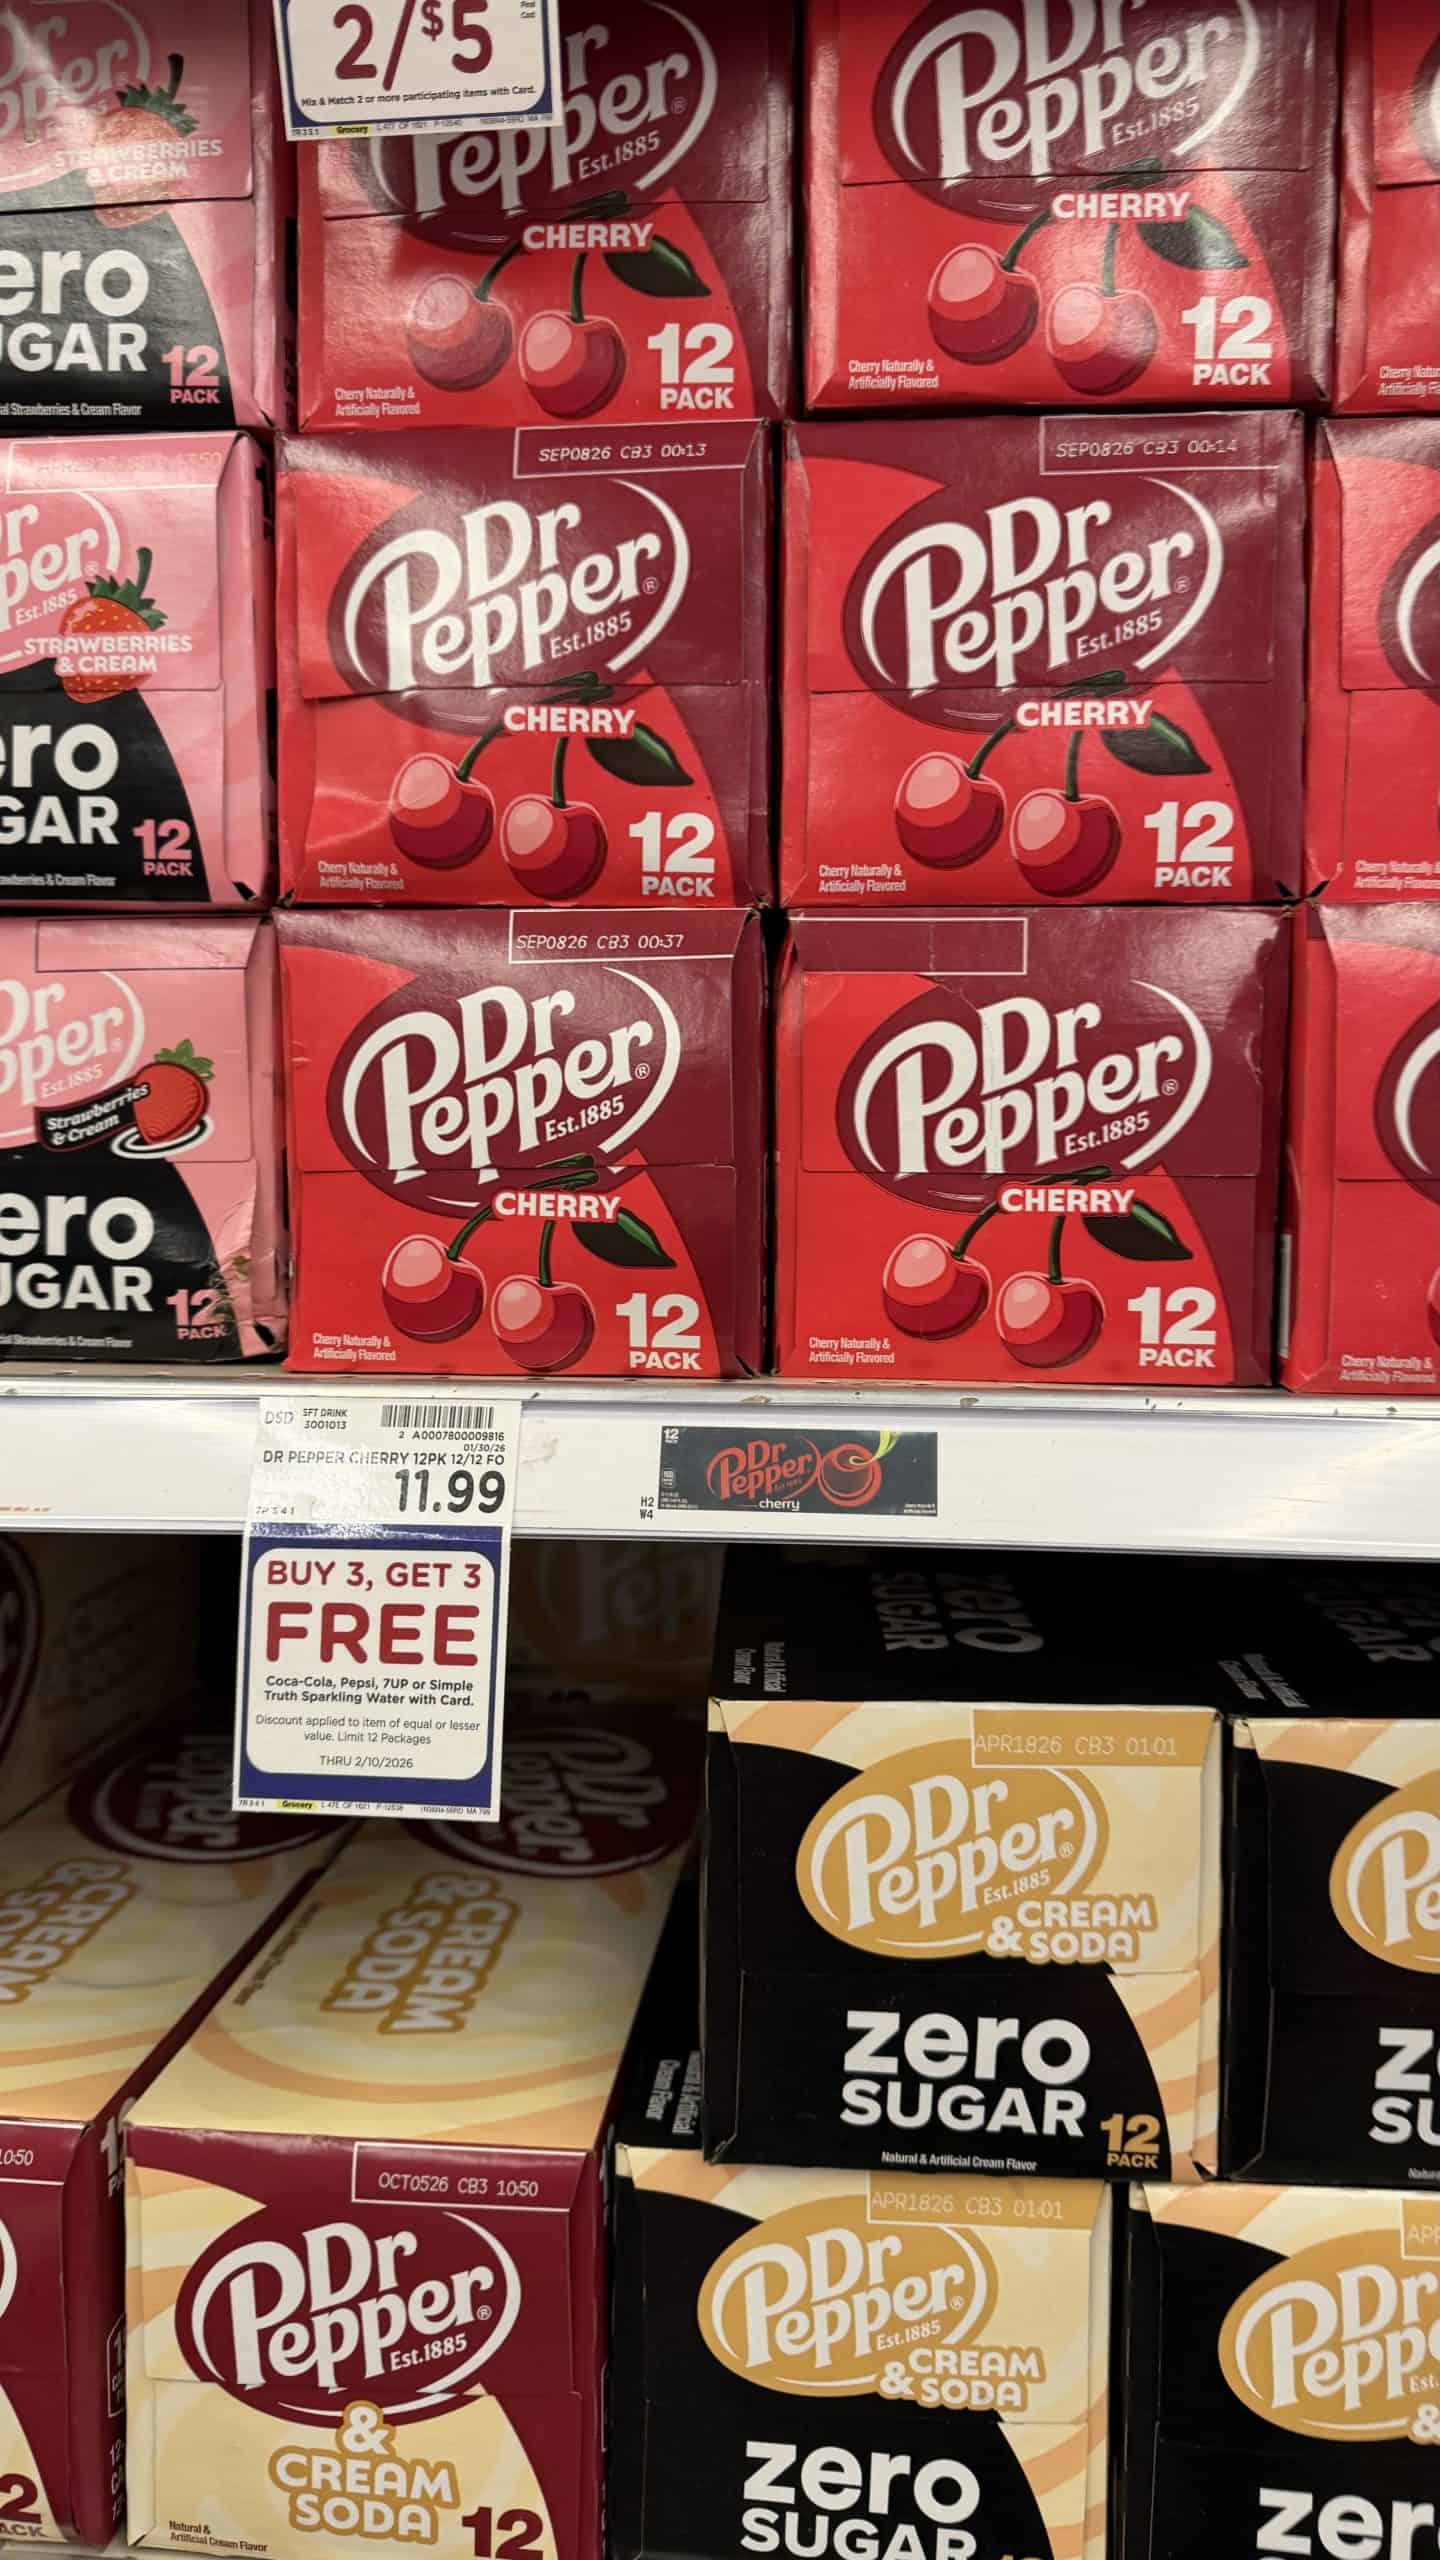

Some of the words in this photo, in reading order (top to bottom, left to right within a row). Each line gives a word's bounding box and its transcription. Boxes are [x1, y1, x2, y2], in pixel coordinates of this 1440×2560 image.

[333, 0, 493, 91] 2/$5
[1024, 0, 1147, 85] Dr
[328, 95, 355, 105] Match
[377, 94, 400, 102] more
[402, 89, 460, 103] participating
[462, 87, 489, 98] items
[490, 86, 510, 96] with
[891, 9, 1232, 188] Pepper
[1051, 191, 1192, 219] CHERRY
[521, 222, 654, 251] CHERRY
[1181, 295, 1272, 360] 12
[161, 344, 220, 387] 12
[1191, 362, 1272, 387] PACK
[169, 388, 220, 404] PACK
[538, 446, 612, 463] SEP0826
[620, 445, 653, 459] CB3
[461, 499, 582, 600] Dr
[985, 496, 1112, 598] Dr
[344, 529, 662, 701] Pepper
[860, 521, 1195, 697] Pepper
[23, 634, 193, 655] STRAWBERRIES
[56, 656, 74, 673] &
[78, 655, 158, 673] CREAM
[502, 705, 637, 735] CHERRY
[1015, 700, 1153, 728] CHERRY
[132, 818, 192, 860] 12
[628, 811, 715, 874] 12
[1143, 799, 1234, 864] 12
[143, 861, 194, 877] PACK
[1154, 865, 1232, 889] PACK
[641, 877, 714, 897] PACK
[514, 935, 588, 950] SEP0826
[596, 934, 630, 950] CB3
[456, 985, 576, 1084] Dr
[977, 996, 1102, 1097] Dr
[46, 1083, 149, 1131] Strawberries
[342, 1011, 654, 1185] Pepper
[853, 1020, 1184, 1180] Pepper
[52, 1131, 66, 1146] &
[67, 1114, 120, 1143] Cream
[494, 1192, 621, 1220] CHERRY
[1001, 1188, 1136, 1214] CHERRY
[166, 1288, 229, 1327] 12
[615, 1291, 702, 1349] 12
[1127, 1285, 1217, 1347] 12
[177, 1327, 227, 1340] PACK
[809, 1336, 838, 1352] Cherry
[840, 1337, 881, 1353] Naturally
[882, 1339, 890, 1350] &
[629, 1351, 702, 1371] PACK
[808, 1351, 852, 1366] Artificially
[854, 1351, 895, 1365] Flavored
[1138, 1348, 1215, 1368] PACK
[264, 1409, 295, 1425] DSD
[302, 1408, 319, 1417] SFT
[320, 1408, 348, 1418] DRINK
[304, 1420, 347, 1430] 3001013
[398, 1431, 406, 1439] 2
[463, 1443, 506, 1452] 01/30/26
[263, 1450, 284, 1464] DR
[288, 1450, 345, 1465] PEPPER
[349, 1451, 410, 1465] CHERRY
[413, 1452, 447, 1466] 12PK
[451, 1452, 483, 1466] 12/12
[486, 1453, 505, 1466] FO
[747, 1439, 787, 1470] Dr
[706, 1447, 813, 1500] Pepper
[394, 1468, 506, 1514] 11.99
[639, 1496, 655, 1508] H2
[758, 1497, 801, 1512] cherry
[639, 1509, 654, 1520] W4
[267, 1560, 336, 1586] BUY
[346, 1561, 374, 1591] 3,
[385, 1562, 453, 1588] GET
[463, 1563, 482, 1589] 3
[266, 1601, 480, 1666] FREE
[264, 1690, 298, 1702] Truth
[301, 1691, 362, 1705] Sparkling
[366, 1693, 405, 1705] Water
[408, 1694, 437, 1706] with
[440, 1694, 475, 1706] Card.
[265, 1675, 337, 1689] Coca-Cola,
[340, 1677, 379, 1691] Pepsi,
[382, 1678, 409, 1690] 7UP
[412, 1680, 425, 1690] or
[429, 1679, 474, 1692] Simple
[255, 1715, 303, 1726] Discount
[305, 1716, 346, 1729] applied
[348, 1717, 360, 1728] to
[362, 1717, 386, 1728] item
[389, 1718, 401, 1728] of
[403, 1719, 433, 1731] equal
[435, 1721, 447, 1730] or
[449, 1720, 480, 1731] lesser
[304, 1731, 334, 1742] value.
[337, 1731, 365, 1742] Limit
[367, 1732, 378, 1742] 12
[381, 1733, 432, 1746] Packages
[974, 1735, 1063, 1754] APR1826
[1074, 1736, 1115, 1755] CB3
[319, 1755, 351, 1767] THRU
[354, 1756, 413, 1769] 2/10/2026
[281, 1800, 313, 1810] Grocery
[910, 1774, 1009, 1855] Dr
[811, 1794, 1075, 1931] Pepper
[1016, 1900, 1152, 1929] CREAM
[986, 1917, 1024, 1954] &
[1029, 1930, 1134, 1959] SODA
[843, 2010, 1091, 2086] zero
[840, 2079, 1087, 2138] SUGAR
[1100, 2113, 1161, 2155] 12
[881, 2151, 918, 2165] Natural
[919, 2153, 928, 2165] &
[928, 2154, 971, 2168] Artificial
[972, 2157, 1005, 2170] Cream
[1006, 2158, 1038, 2172] Flavor
[1106, 2154, 1160, 2169] PACK
[378, 2172, 450, 2193] OCT0526
[457, 2177, 488, 2195] CB3
[302, 2221, 418, 2314] Dr
[806, 2227, 903, 2303] Dr
[191, 2240, 495, 2394] Pepper
[711, 2243, 965, 2368] Pepper
[342, 2406, 389, 2455] &
[275, 2453, 454, 2503] CREAM
[743, 2440, 980, 2524] zero
[168, 2519, 202, 2534] Natural
[203, 2525, 212, 2535] &
[294, 2493, 432, 2539] SODA
[169, 2532, 208, 2546] Artificial
[209, 2537, 239, 2550] Cream
[239, 2539, 268, 2553] Flavor
[461, 2506, 544, 2560] 12
[740, 2507, 977, 2560] SUGAR
